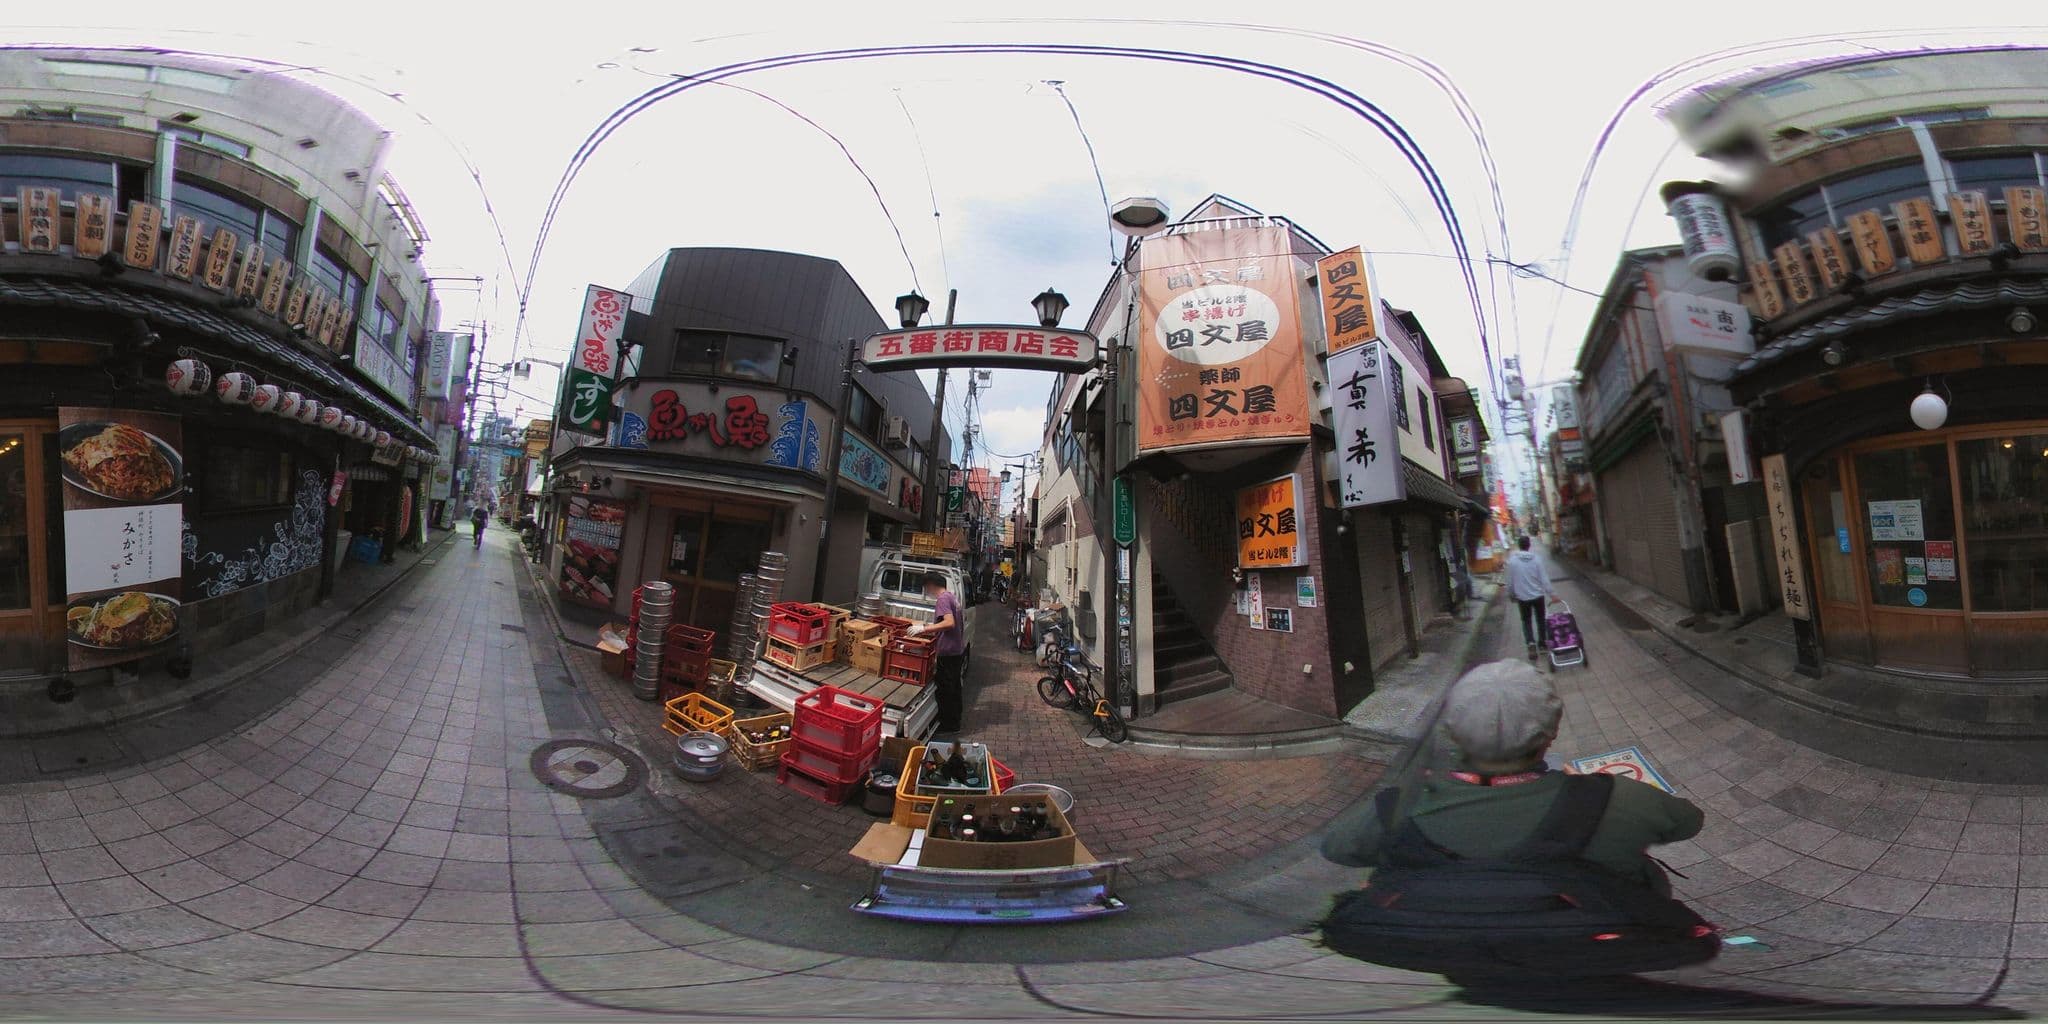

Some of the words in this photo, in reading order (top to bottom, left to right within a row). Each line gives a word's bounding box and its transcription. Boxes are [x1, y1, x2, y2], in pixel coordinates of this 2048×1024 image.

[1181, 303, 1246, 322] 串揚げ
[1326, 260, 1369, 337] 四文屋
[876, 331, 1079, 358] 五番街商店会
[1165, 320, 1269, 350] 四文屋
[432, 334, 446, 377] CLOVER
[1199, 367, 1241, 386] 薬師
[571, 376, 608, 425] すし
[1168, 384, 1276, 421] 四文屋
[948, 487, 962, 511] すし
[1239, 507, 1297, 540] 四文屋
[122, 522, 136, 566] みかさ
[1248, 546, 1289, 561] 当ビル2階
